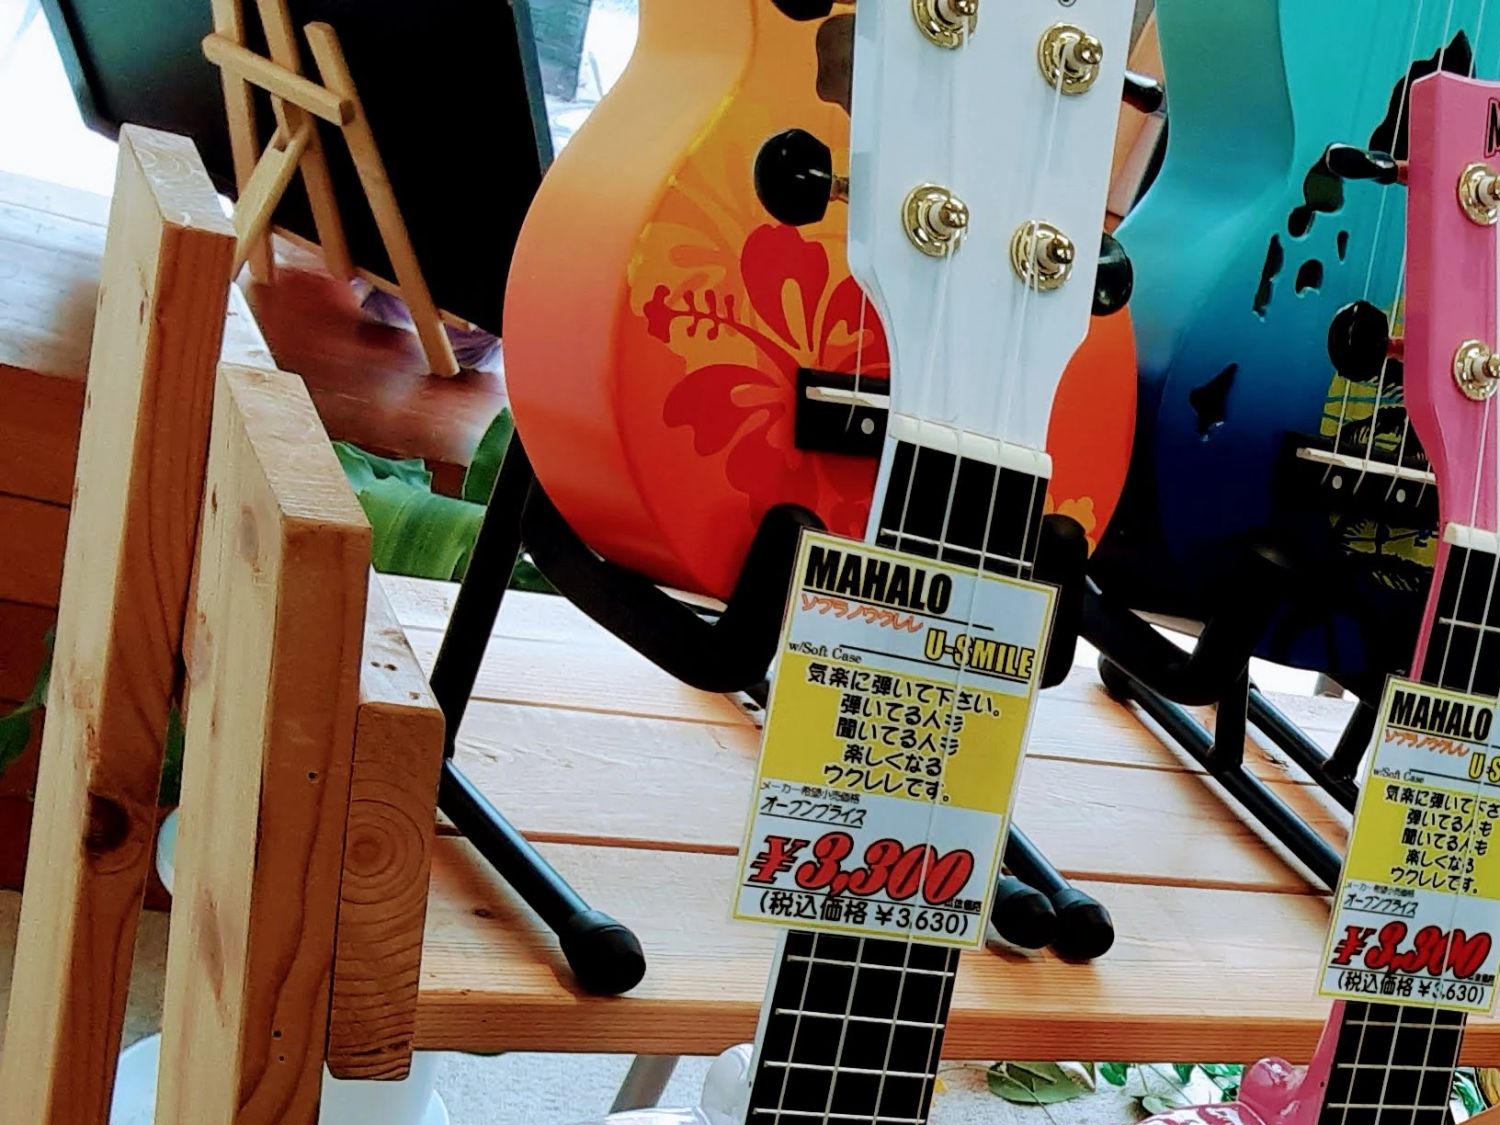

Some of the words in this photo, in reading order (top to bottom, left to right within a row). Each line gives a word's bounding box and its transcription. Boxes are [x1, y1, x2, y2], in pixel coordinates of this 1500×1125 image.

[803, 545, 953, 615] MAHALO
[789, 641, 828, 657] w/Soft
[832, 646, 862, 664] Case
[925, 628, 1036, 679] U-SMILE
[807, 662, 1001, 718] 気楽に弾いて下さい。
[840, 693, 963, 733] 弾いてる人も
[1387, 690, 1493, 741] MAHALO
[835, 716, 960, 756] 聞いてる人も
[843, 744, 942, 777] 楽しくなる
[823, 764, 951, 803] ウクレレです。
[1407, 808, 1492, 837] 弾いてる人も
[748, 831, 975, 905] ¥3,300
[1390, 867, 1478, 894] ウクレレです。
[1405, 849, 1474, 873] 楽しくなる
